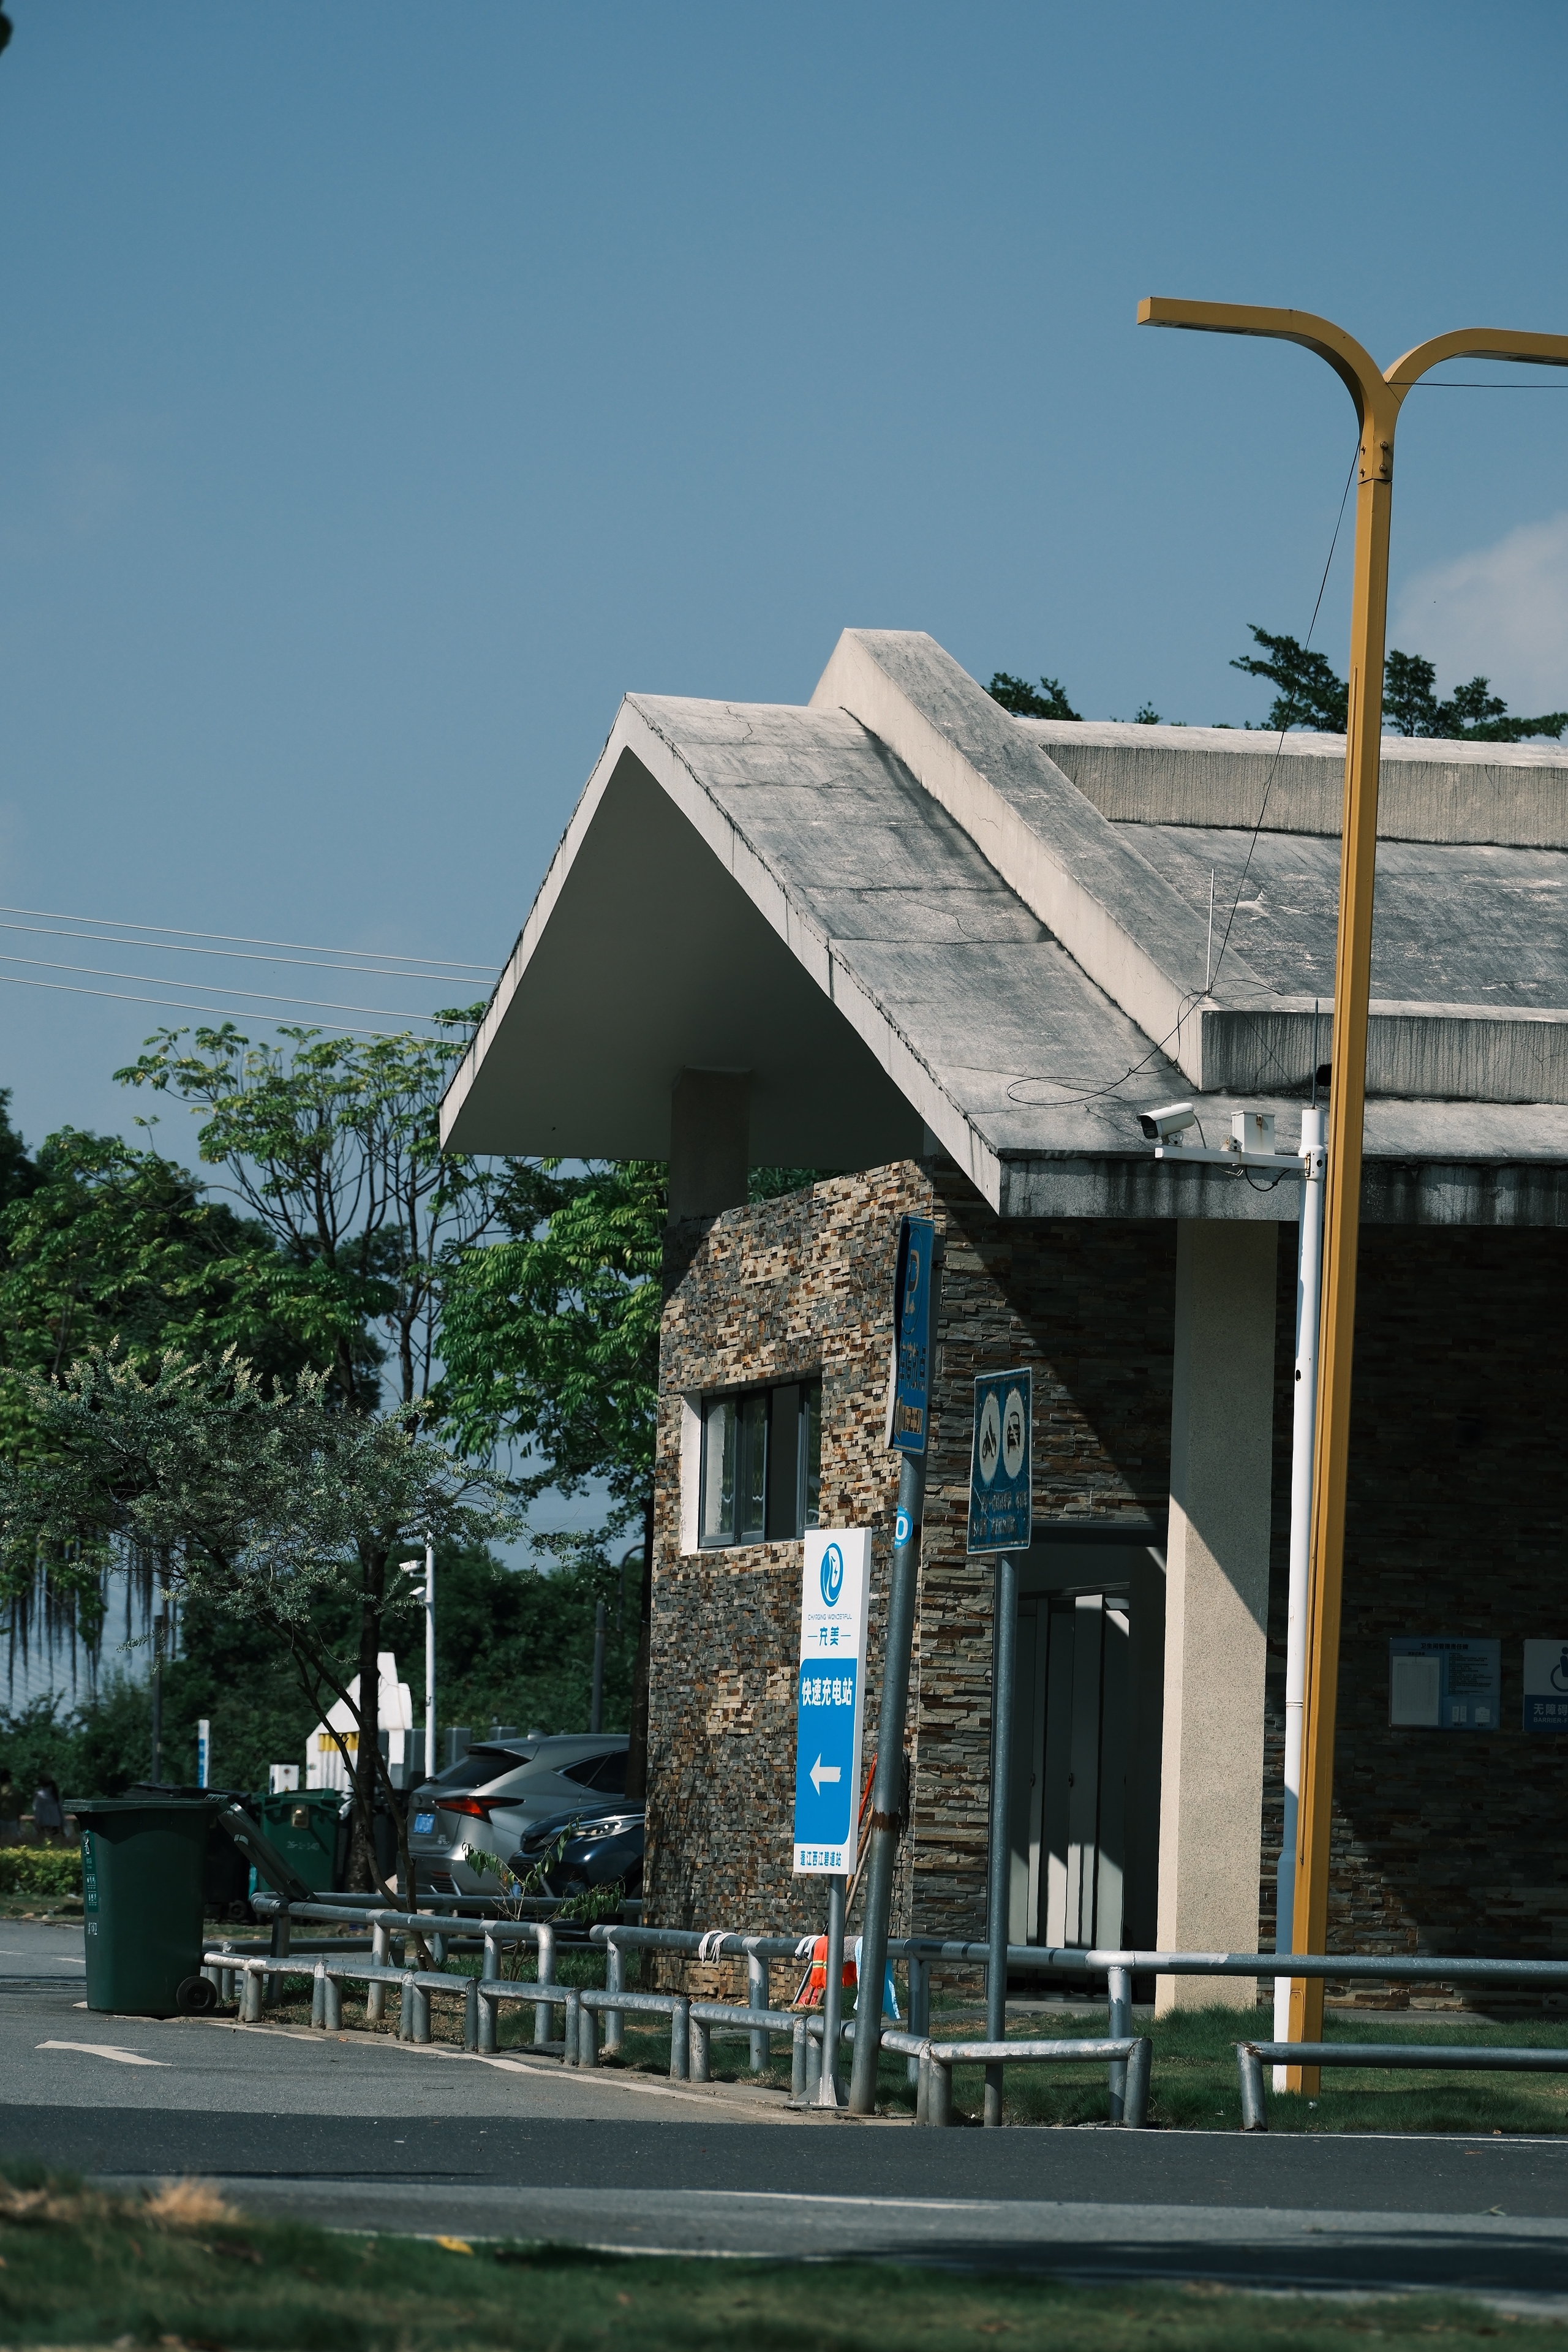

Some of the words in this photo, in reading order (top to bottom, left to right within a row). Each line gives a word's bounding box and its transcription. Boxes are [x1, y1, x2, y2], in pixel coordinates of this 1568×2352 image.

[905, 1248, 920, 1318] P
[819, 1626, 839, 1646] 充美
[801, 1676, 853, 1706] 快速充电站
[1533, 1703, 1568, 1716] 无障碍
[800, 1850, 842, 1867] 蓬江西江碧道站
